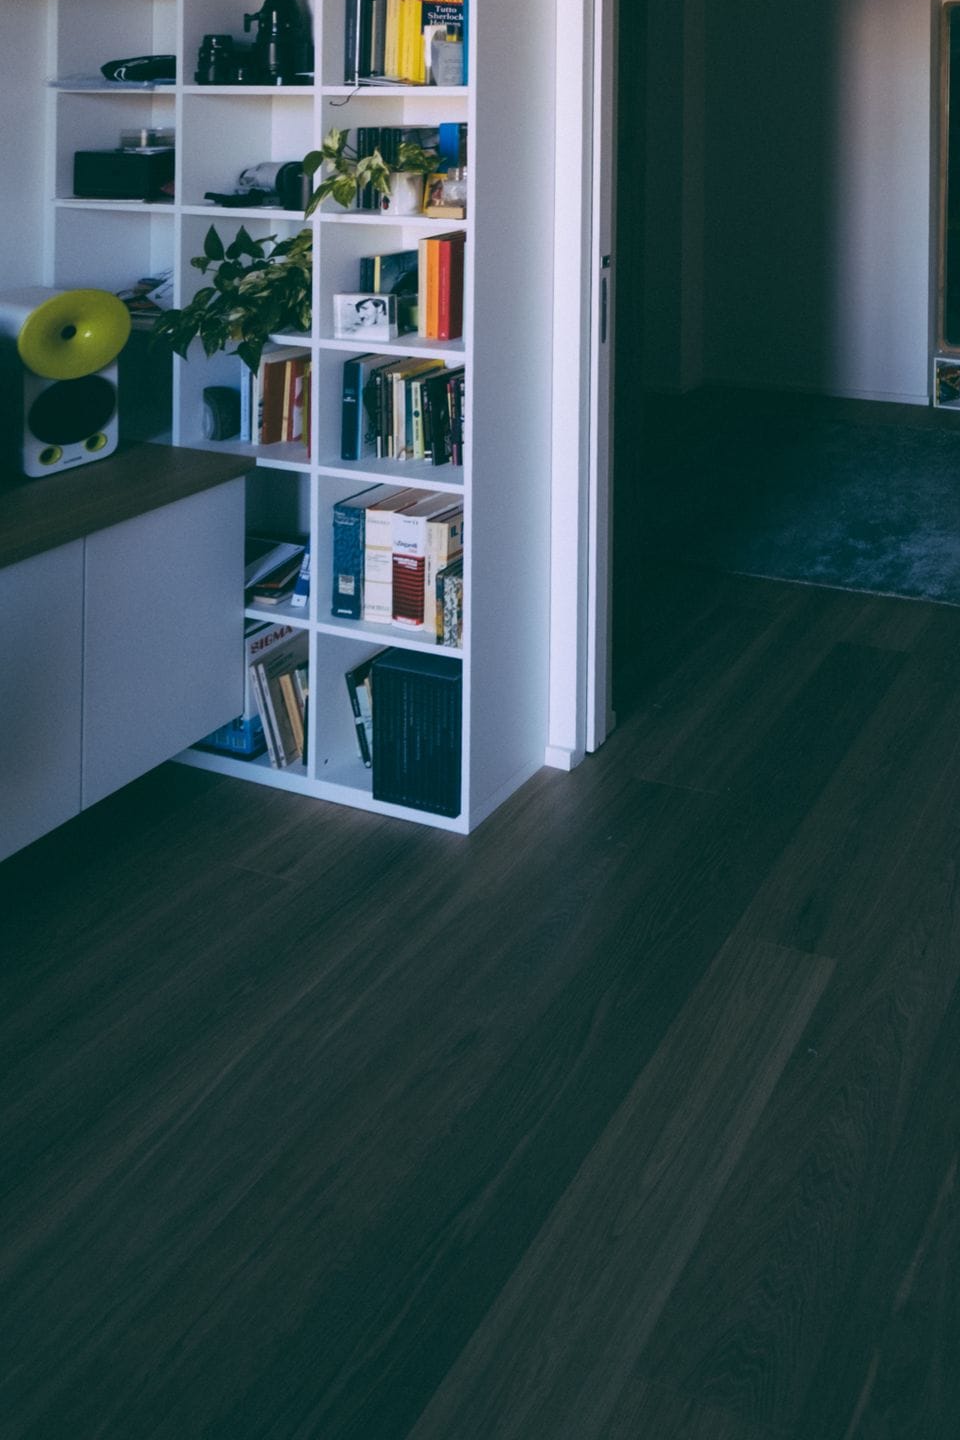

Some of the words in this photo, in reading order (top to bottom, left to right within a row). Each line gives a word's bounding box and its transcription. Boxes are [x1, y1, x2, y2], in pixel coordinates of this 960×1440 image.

[435, 5, 457, 13] Tutto
[427, 12, 464, 21] Sherlock
[250, 625, 293, 654] SIGMA
